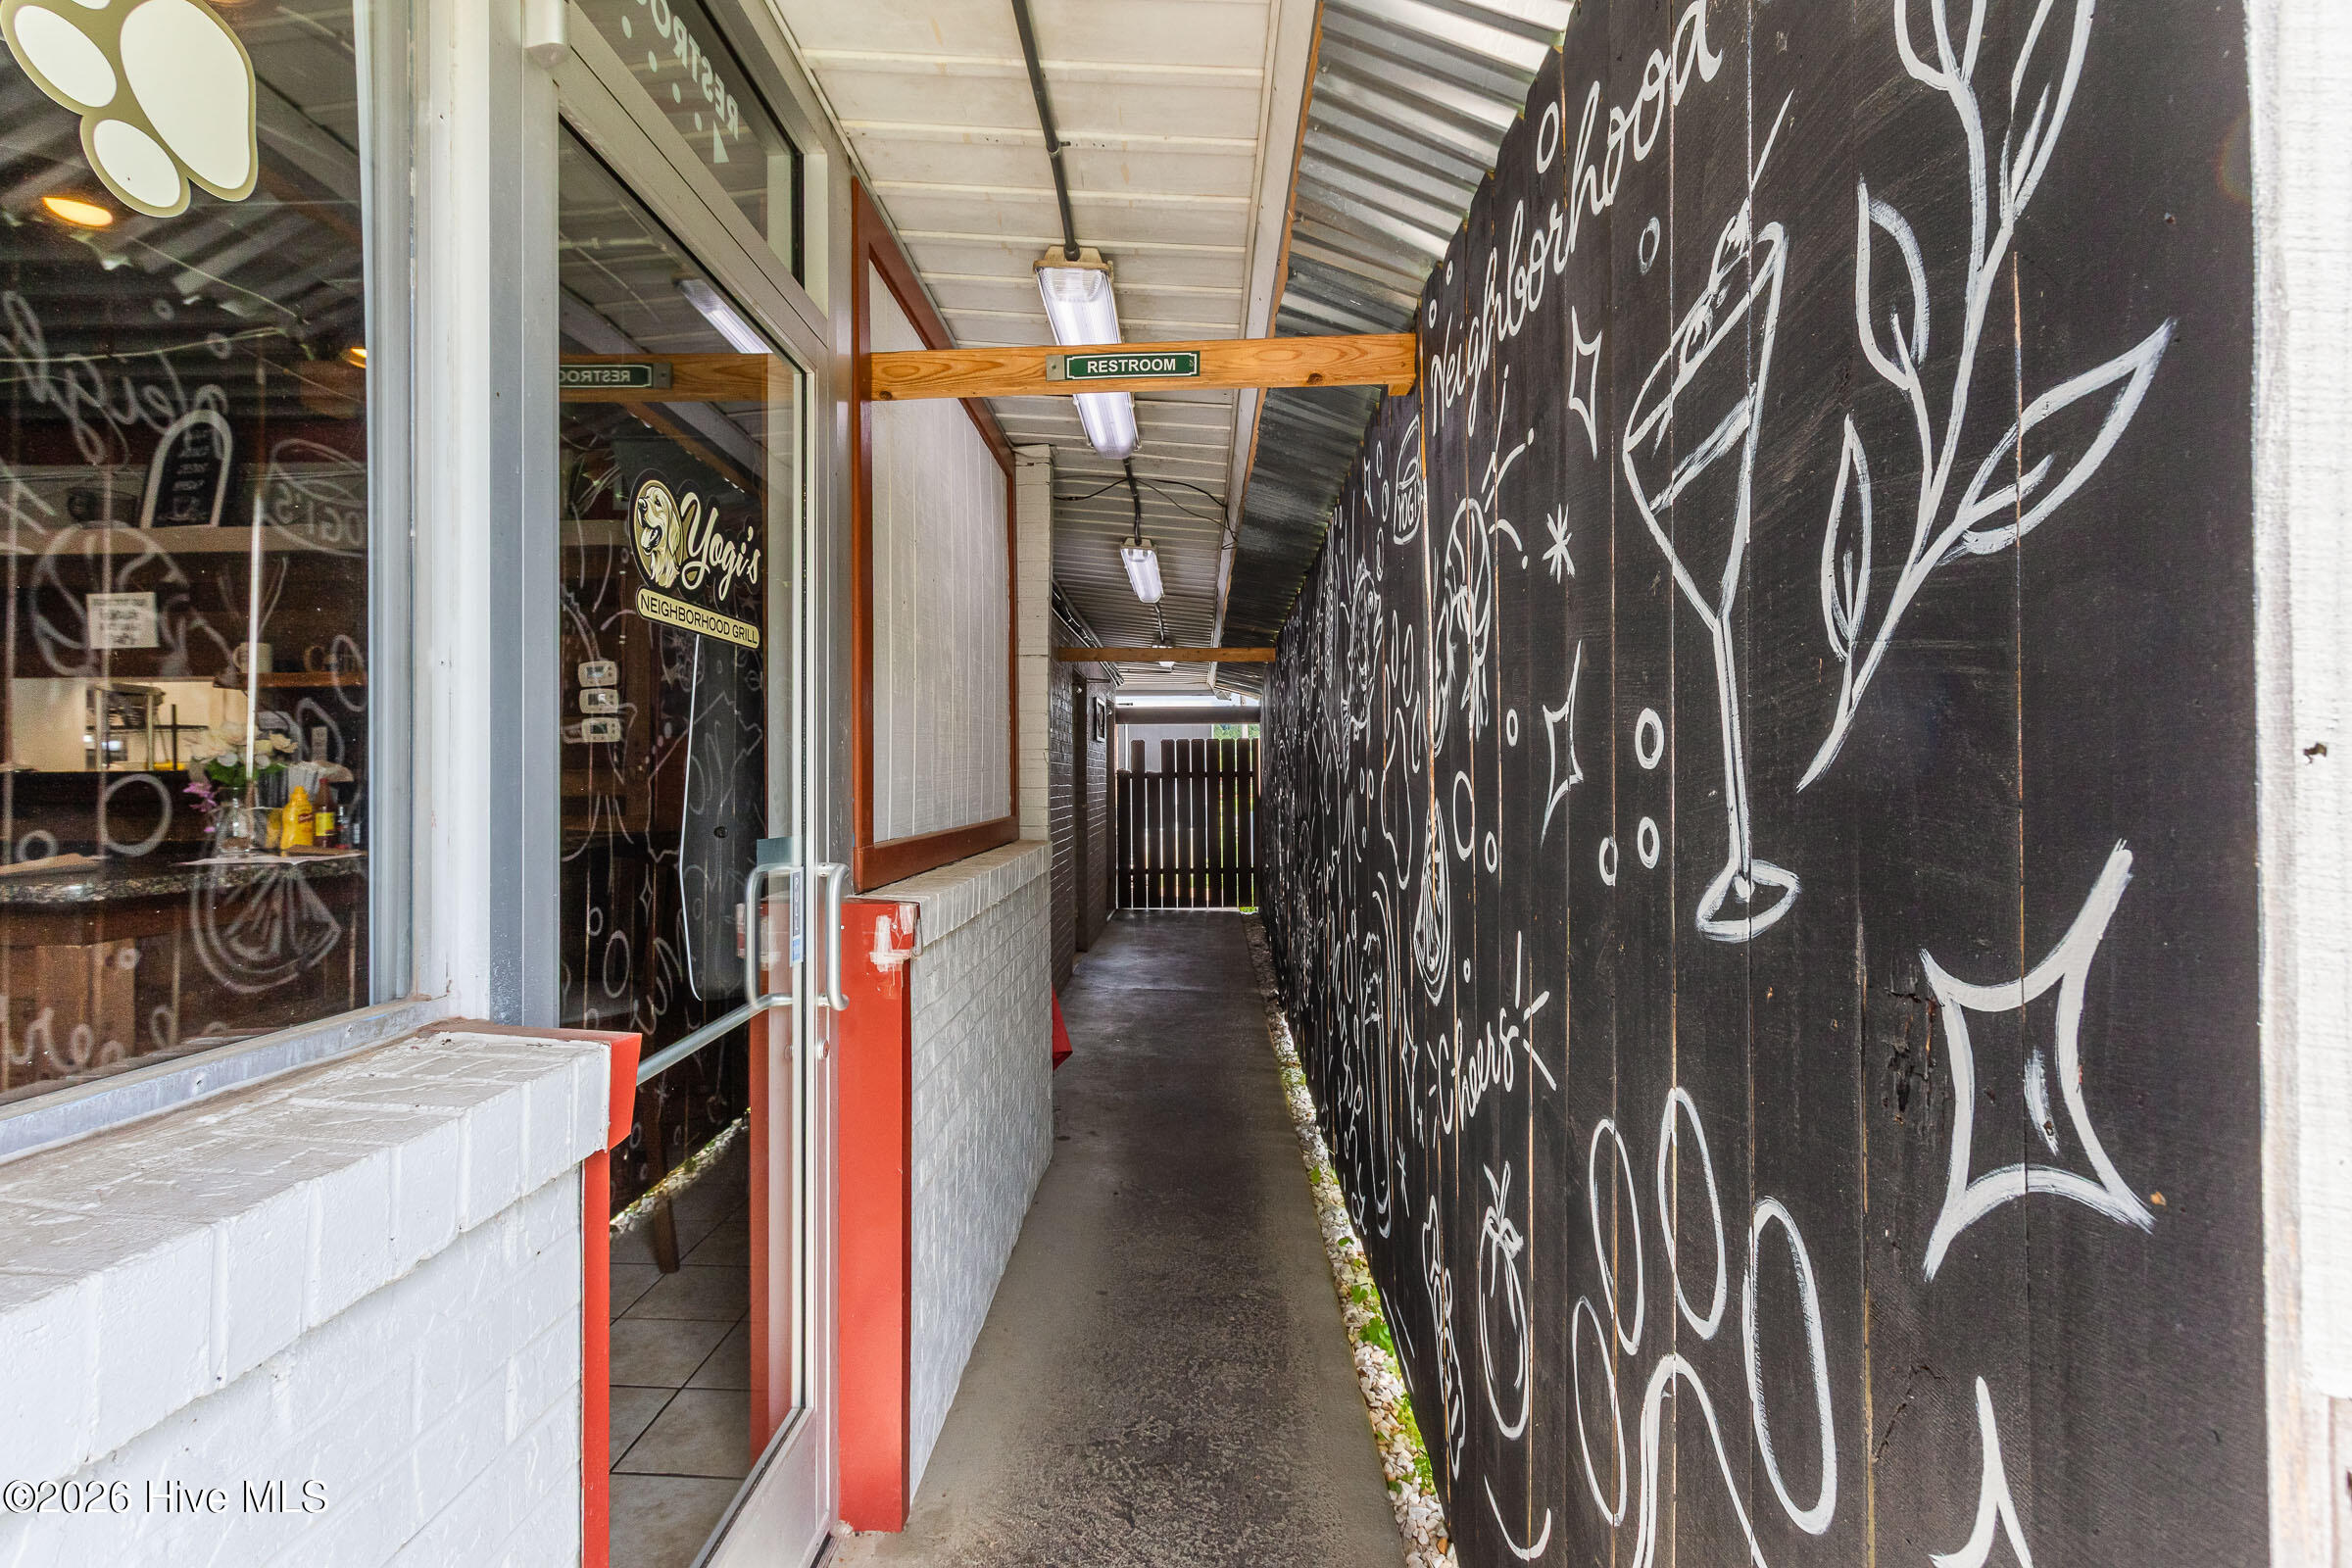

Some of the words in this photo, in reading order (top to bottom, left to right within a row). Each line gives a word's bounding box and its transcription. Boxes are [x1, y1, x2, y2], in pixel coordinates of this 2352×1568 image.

[1087, 358, 1176, 373] RESTROOM
[680, 491, 761, 601] Yogi's
[640, 594, 730, 634] NEIGHBORHOOD
[732, 624, 758, 645] GRILL
[1438, 1006, 1519, 1135] Cheers
